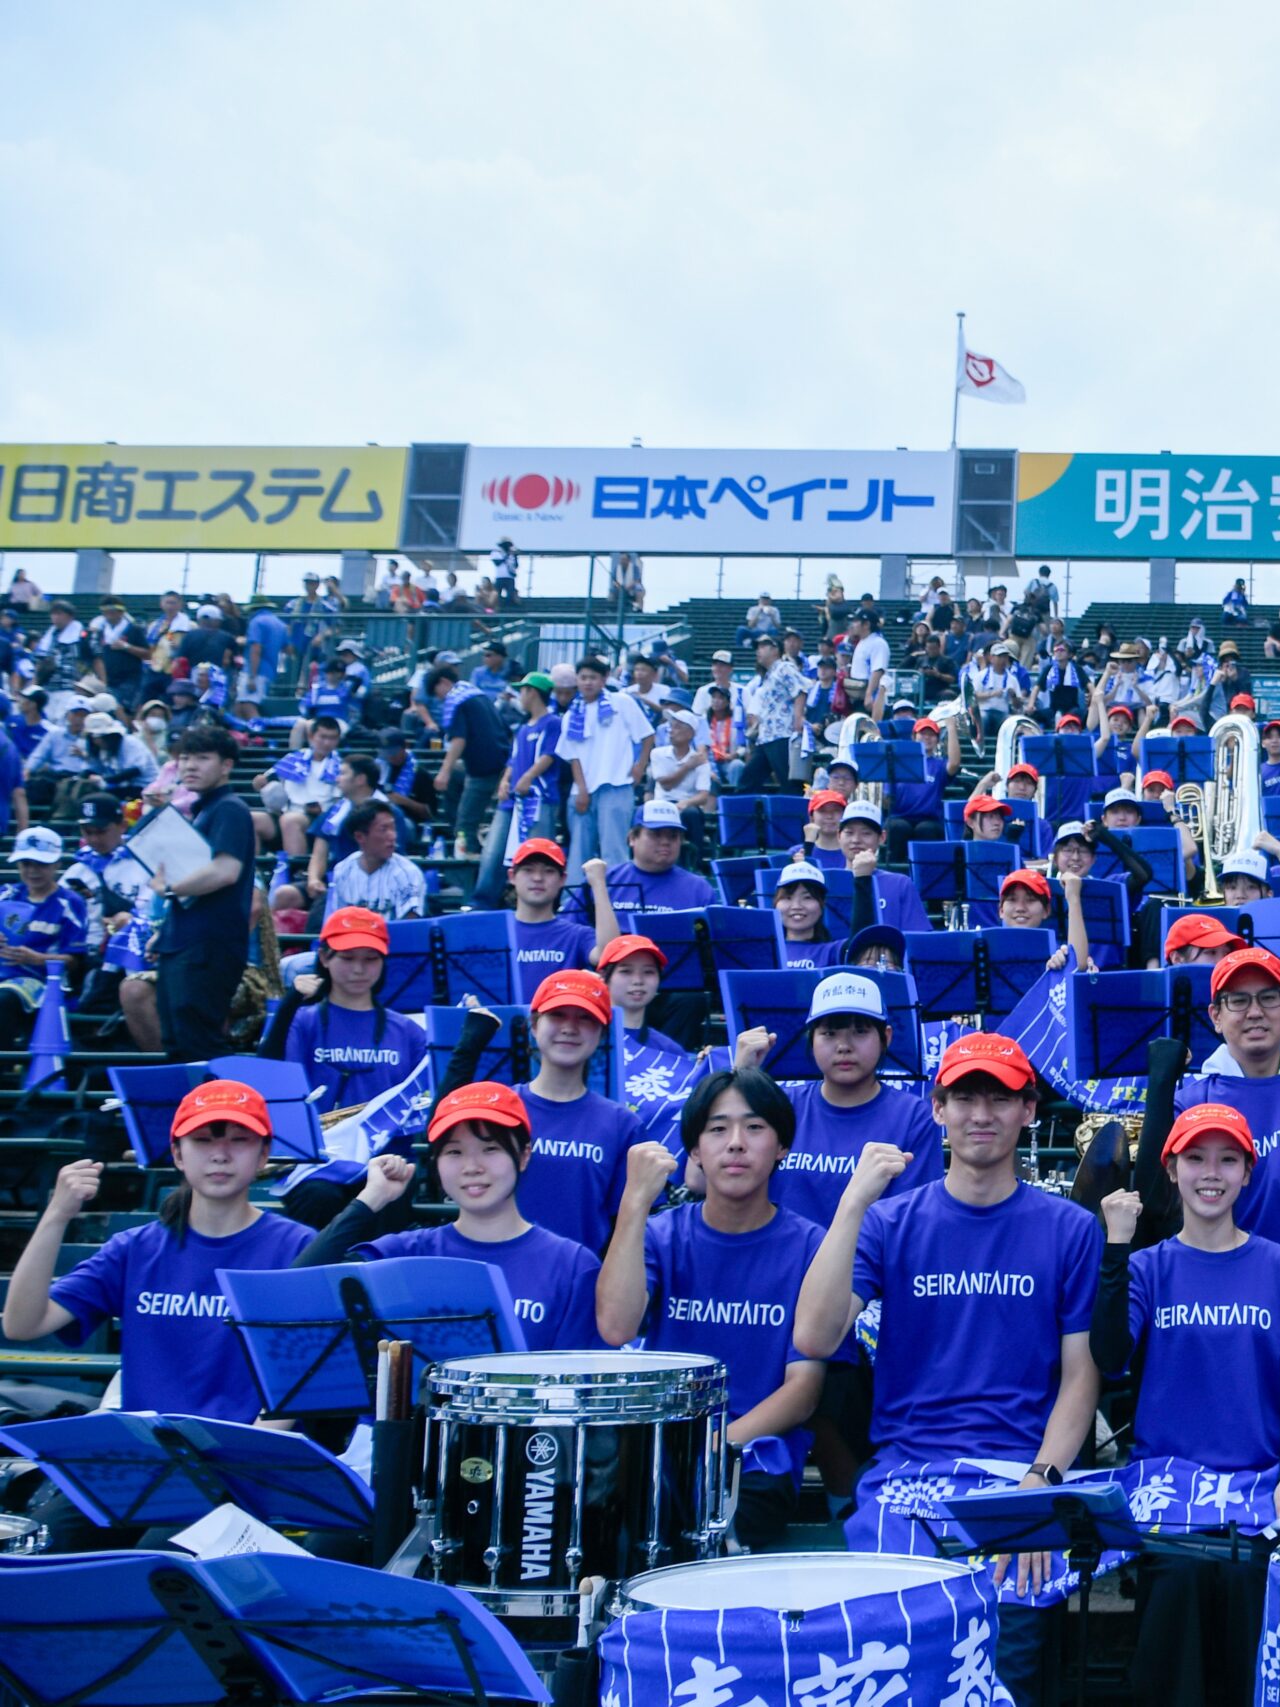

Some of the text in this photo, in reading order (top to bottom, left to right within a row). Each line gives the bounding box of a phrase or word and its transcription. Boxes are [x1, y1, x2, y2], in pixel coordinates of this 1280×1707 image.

[8, 461, 383, 525] 日商エステム
[591, 474, 935, 523] 日本ペイント
[516, 949, 565, 963] ANTAITO
[532, 1138, 604, 1164] ANTAITO
[778, 1152, 857, 1176] SEIRANTA
[912, 1270, 1035, 1298] SEIRANTAITO
[136, 1290, 232, 1318] SEIRANTA
[667, 1296, 786, 1327] SEIRANTAITO
[1154, 1301, 1272, 1330] SEIRANTAITO
[520, 1467, 557, 1581] YAMAHA
